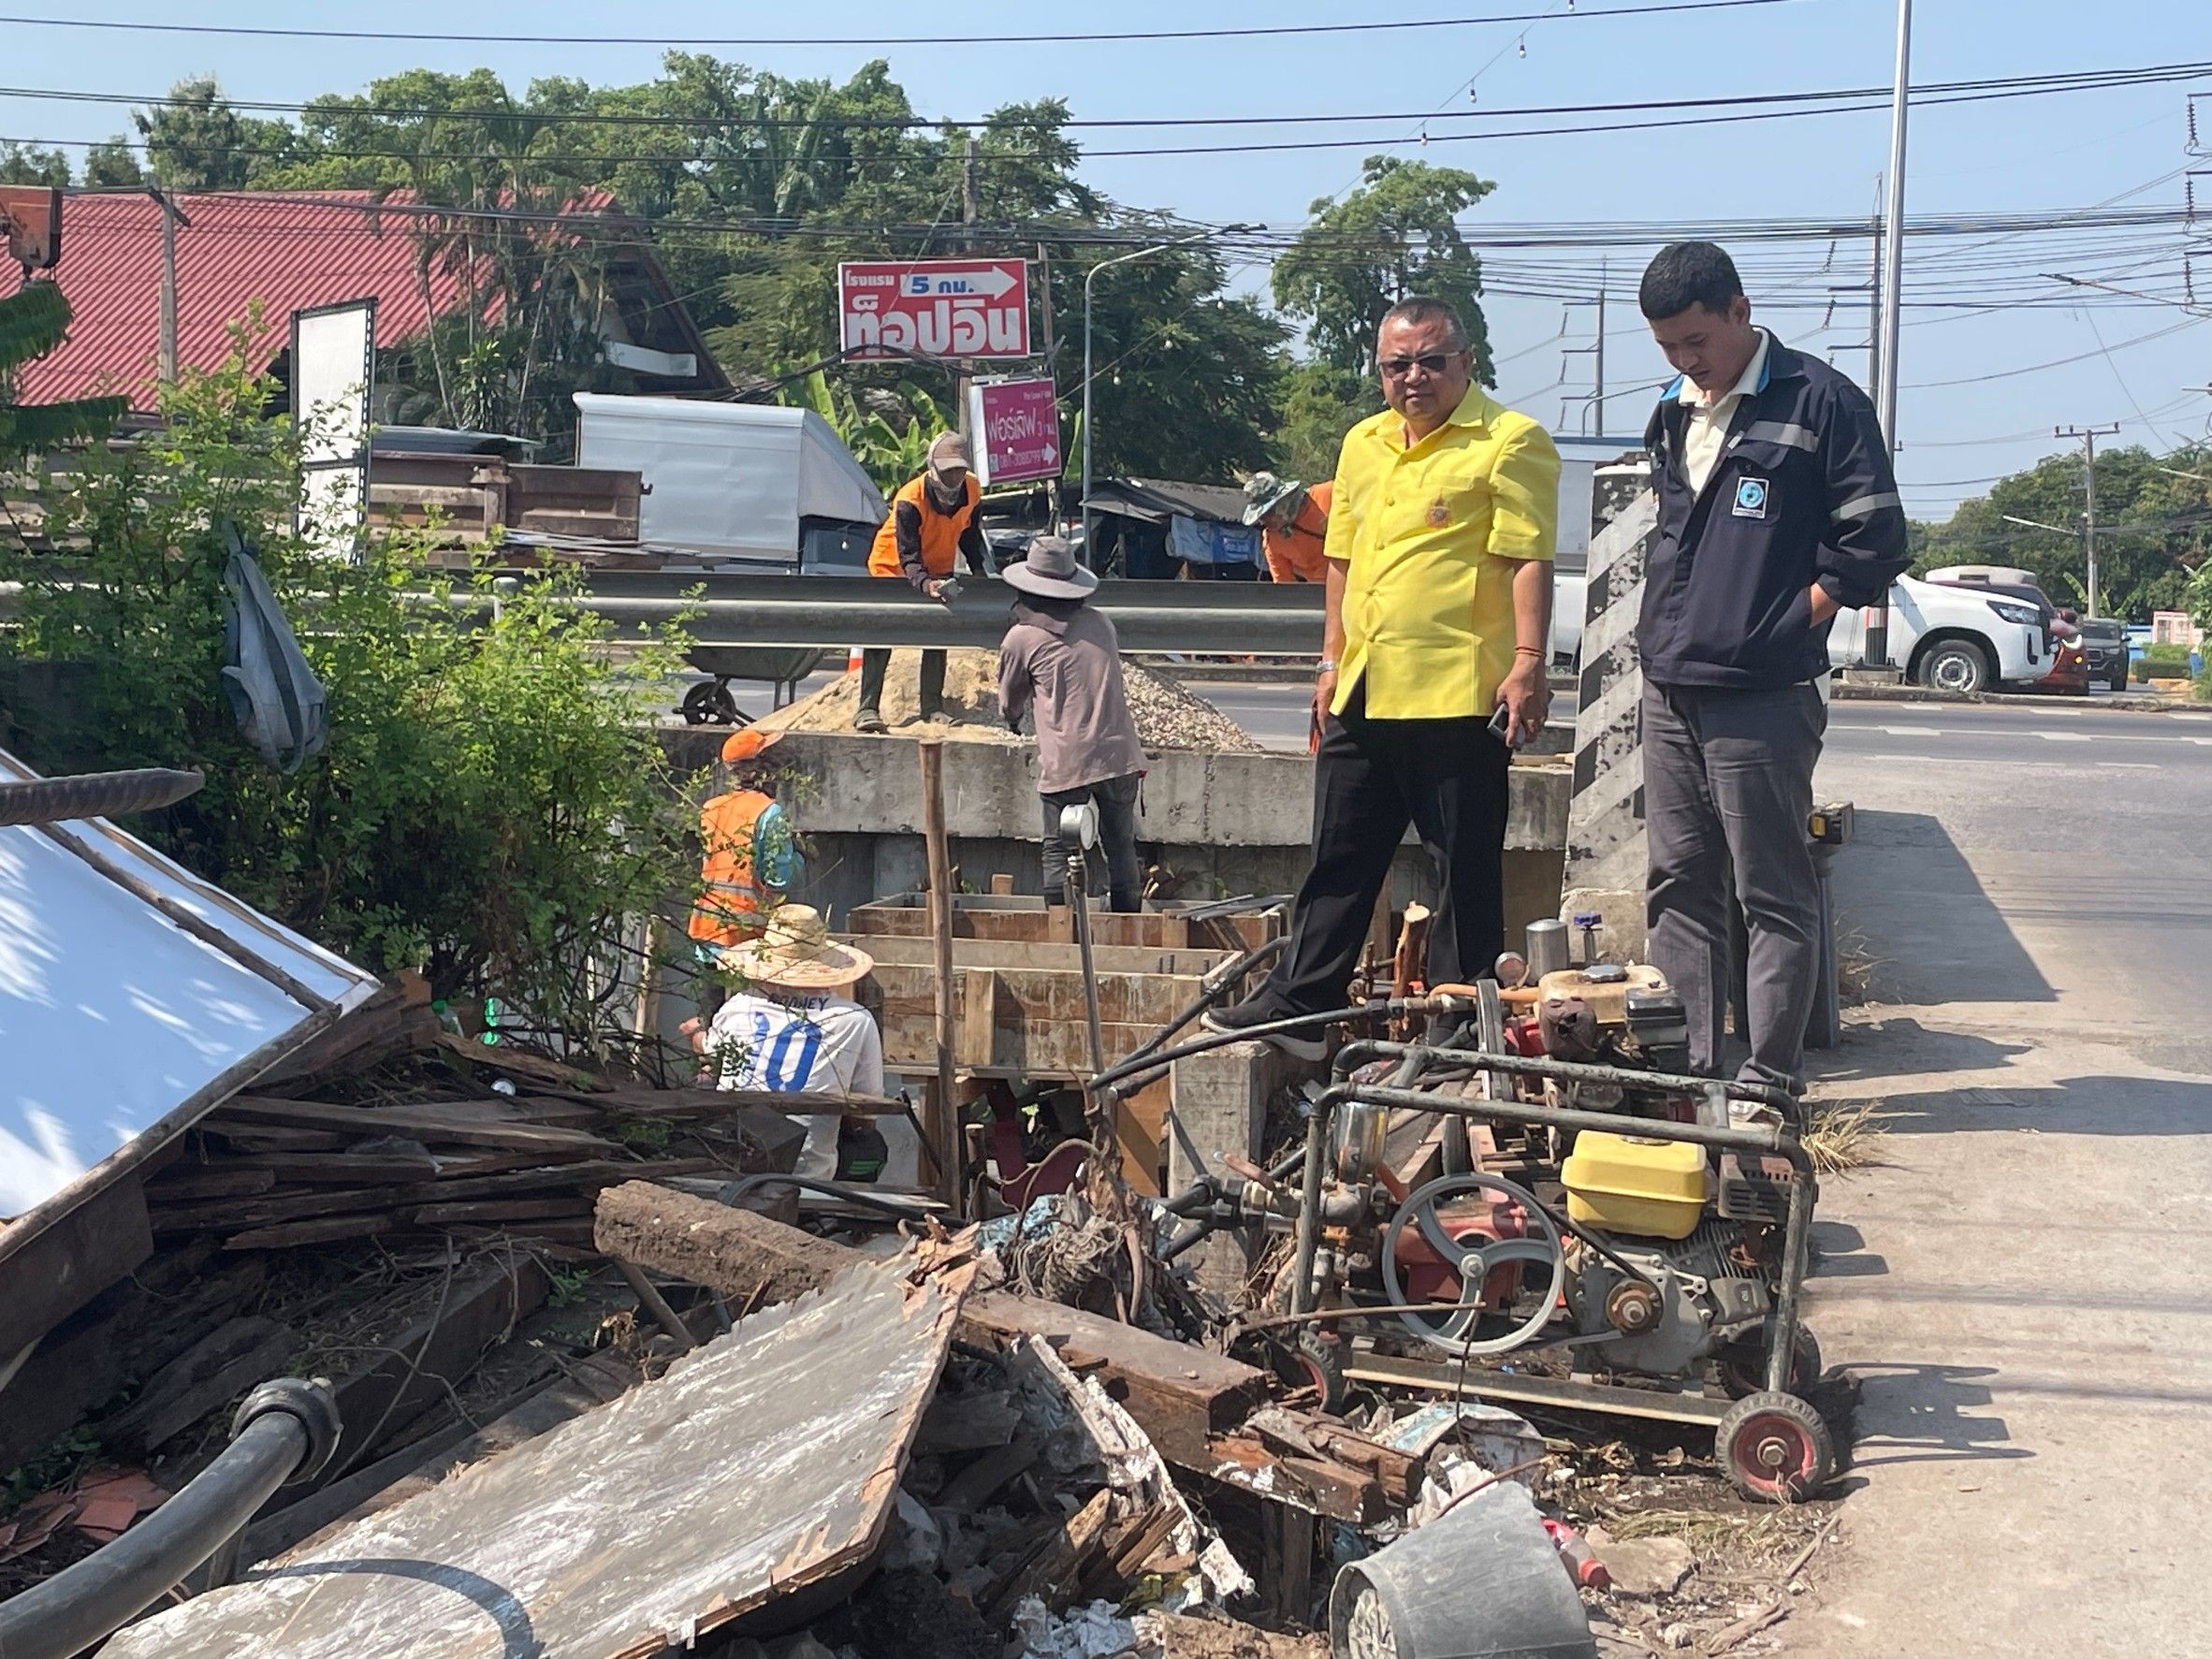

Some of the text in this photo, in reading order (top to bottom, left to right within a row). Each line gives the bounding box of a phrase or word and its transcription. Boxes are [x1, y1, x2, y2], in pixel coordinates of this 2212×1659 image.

[845, 269, 895, 287] โรงแรม
[910, 276, 974, 294] 5 กม.
[846, 294, 1021, 356] ท็อปอิน
